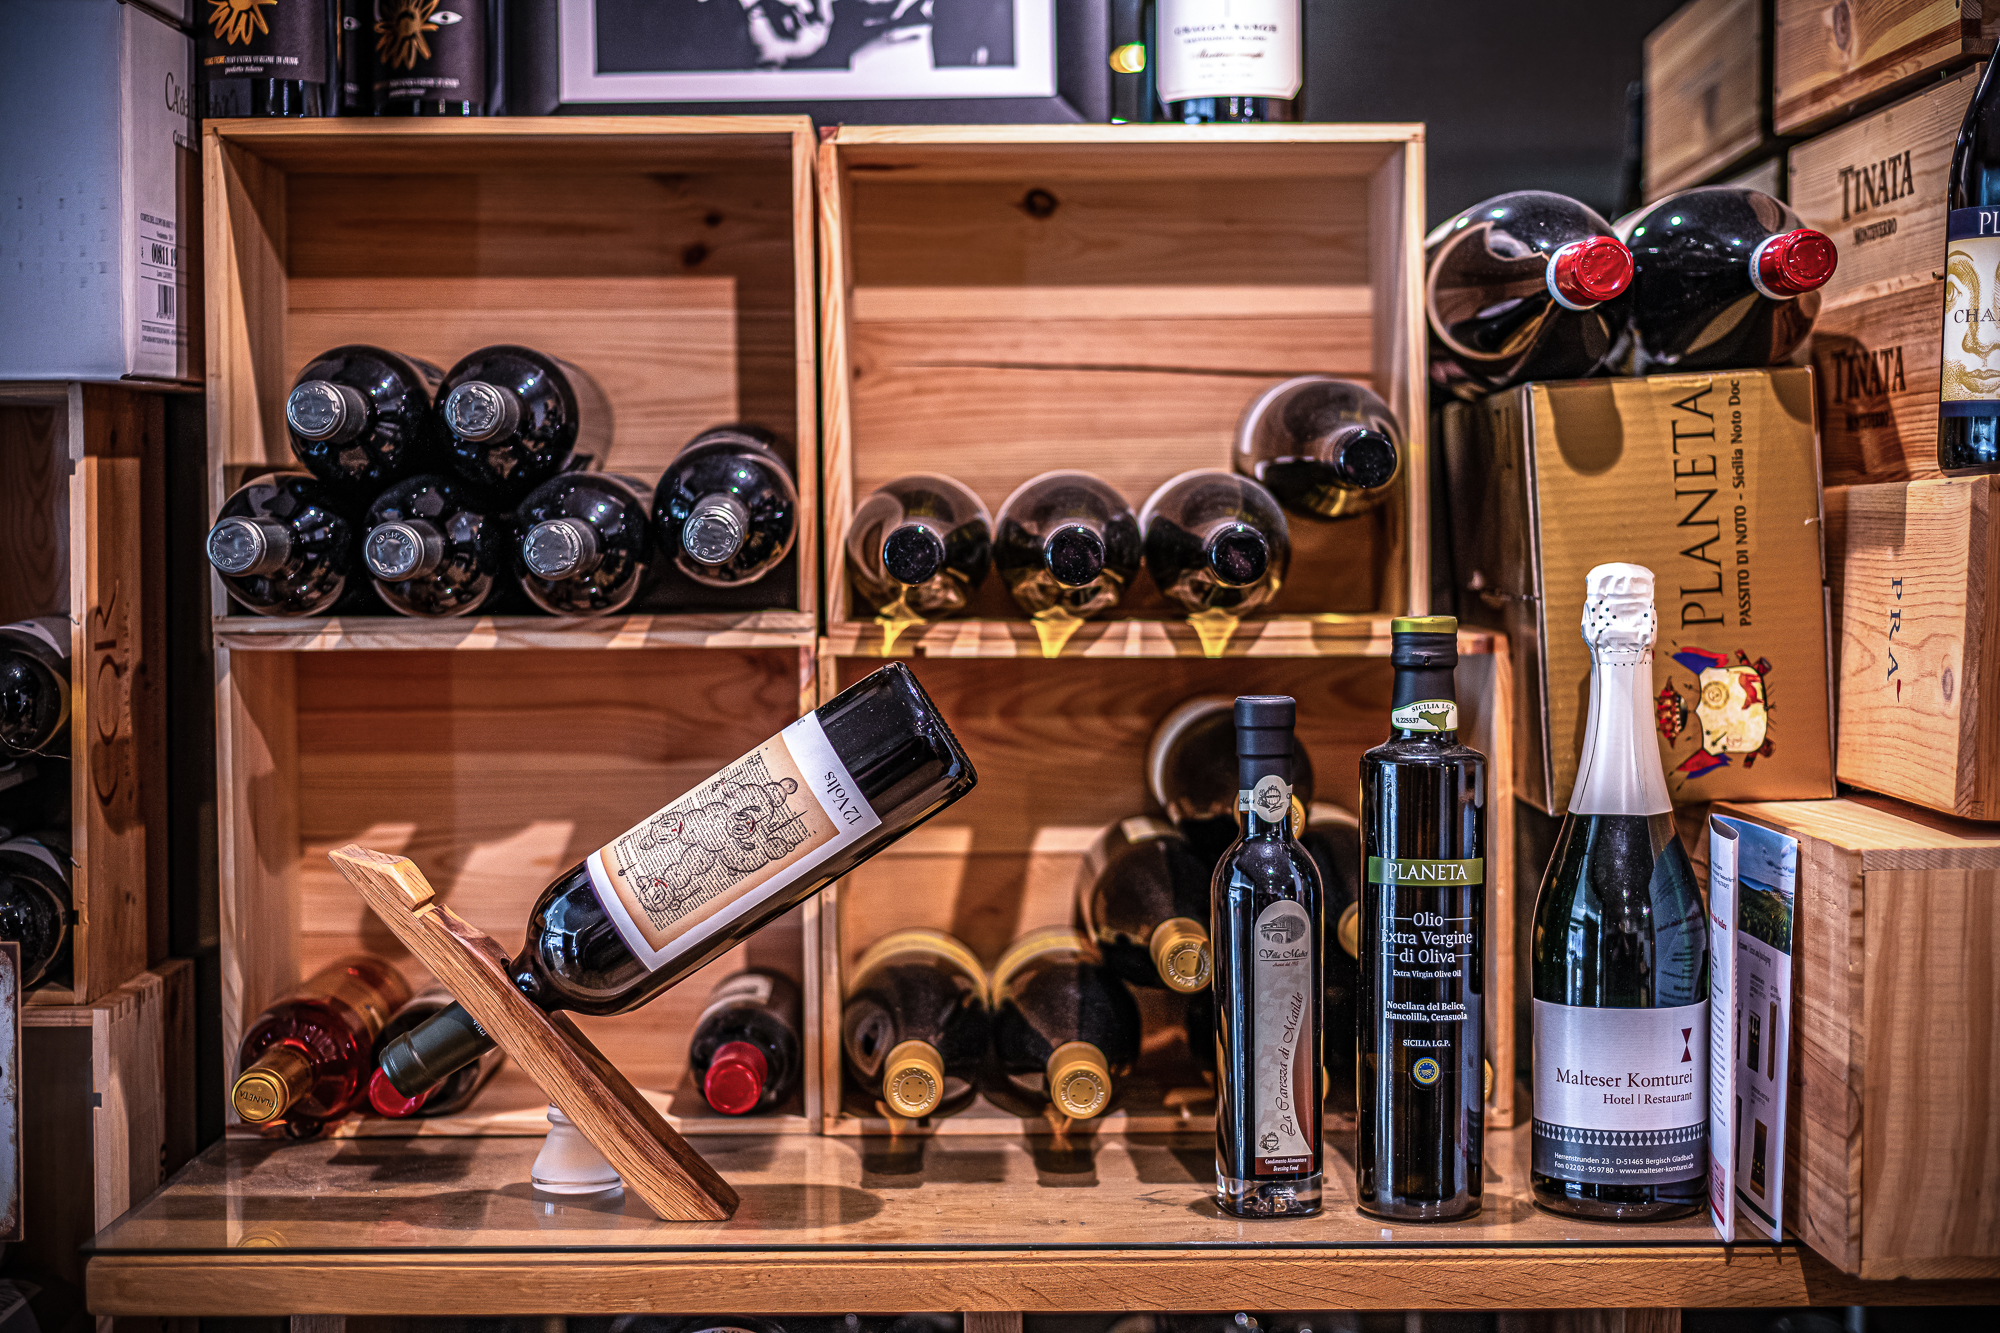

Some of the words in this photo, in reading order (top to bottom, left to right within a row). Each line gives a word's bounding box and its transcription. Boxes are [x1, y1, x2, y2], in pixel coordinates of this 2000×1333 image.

[1838, 150, 1915, 222] TINATA
[1954, 308, 2000, 324] CHA
[1728, 380, 1740, 407] Doc
[1730, 410, 1742, 444] Noto
[1732, 448, 1746, 489] Sicilia
[1671, 382, 1725, 630] PLANETA
[1734, 505, 1748, 546] NOTO
[1736, 550, 1750, 565] DI
[1737, 565, 1752, 627] PASSITO
[1411, 703, 1439, 712] SICILIA
[824, 771, 850, 812] Volts
[842, 806, 864, 826] 12
[1388, 863, 1467, 880] PLANETA
[1413, 912, 1443, 926] Olio
[1381, 929, 1417, 944] Extra
[1421, 931, 1473, 948] Vergine
[1399, 948, 1413, 962] di
[1418, 949, 1455, 963] Oliva
[1412, 970, 1433, 979] Virgin
[1387, 1001, 1425, 1010] Nocellara
[1441, 1002, 1465, 1010] Belice,
[1283, 992, 1303, 1044] Matilde
[1385, 1011, 1430, 1022] Biancolilla,
[1431, 1012, 1468, 1021] Cerasuola
[1278, 1047, 1290, 1060] di
[1276, 1062, 1290, 1110] Carezza
[1556, 1068, 1621, 1087] Malteser
[1627, 1068, 1693, 1087] Komturei
[240, 1090, 274, 1107] PLANETA
[1603, 1094, 1634, 1104] Hotel
[1644, 1092, 1692, 1104] Restaurant
[1280, 1114, 1296, 1136] La
[1619, 1162, 1694, 1174] www.malteser-komturei.de
[1646, 1157, 1671, 1165] Bergisch
[1672, 1153, 1694, 1162] Gladbach
